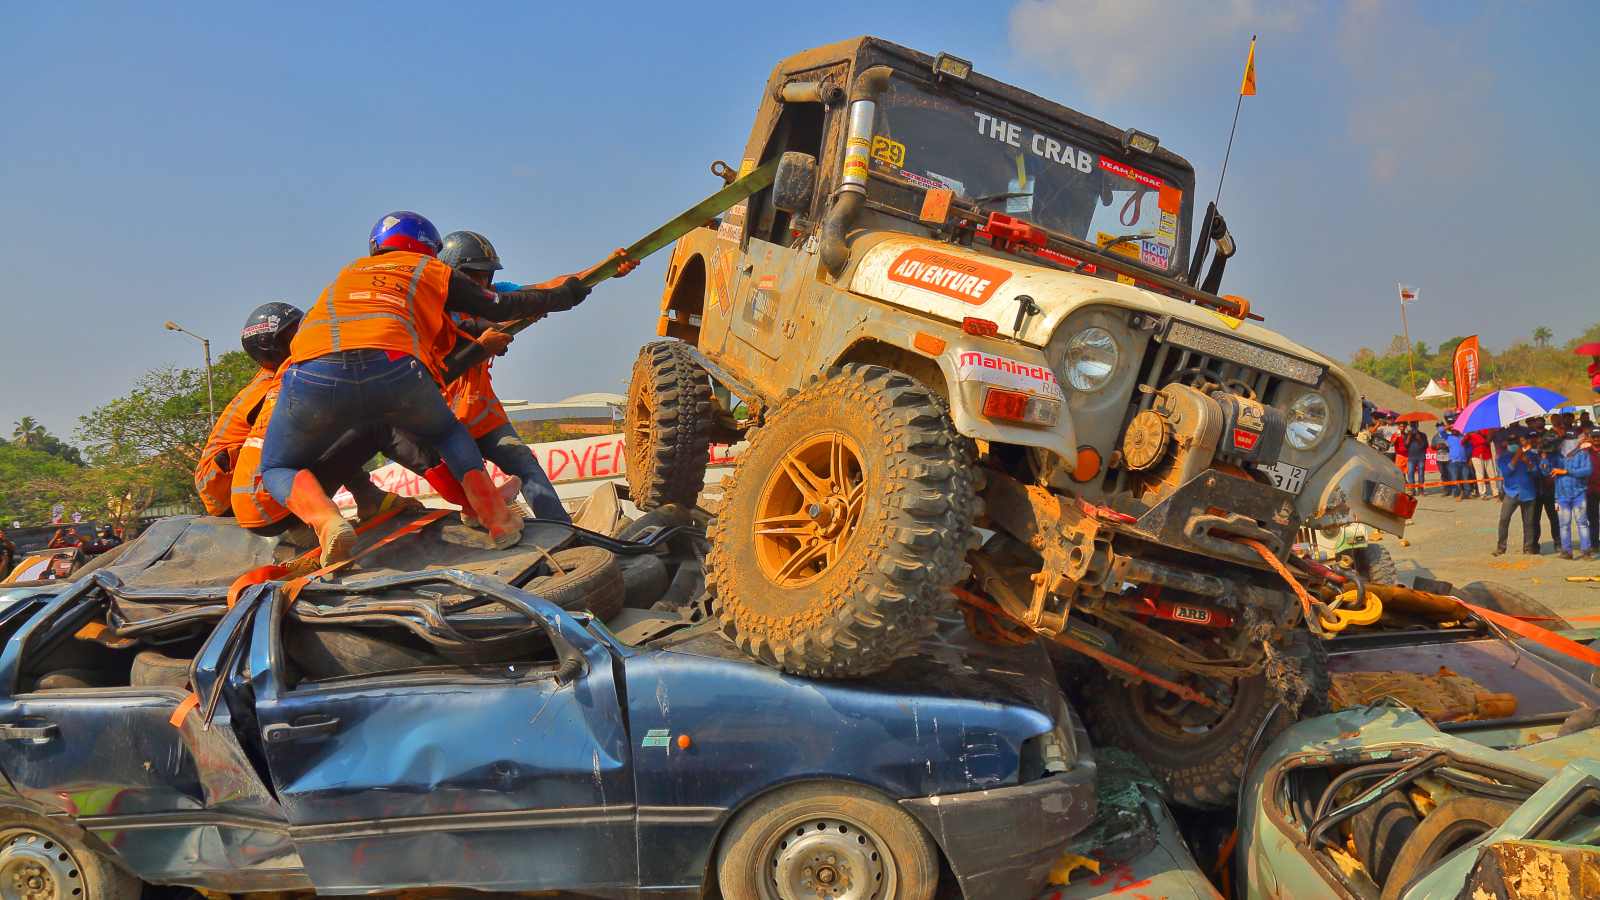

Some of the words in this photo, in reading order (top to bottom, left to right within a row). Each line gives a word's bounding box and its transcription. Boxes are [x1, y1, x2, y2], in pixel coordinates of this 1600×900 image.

[873, 138, 904, 164] 29
[974, 111, 1023, 148] THE
[1031, 133, 1093, 174] CRAB
[1099, 158, 1129, 176] TEAM
[1142, 240, 1169, 258] LIQUI
[1141, 252, 1169, 269] MOLY
[893, 258, 992, 299] ADVENTURE
[1290, 466, 1303, 479] 12
[1177, 607, 1207, 621] ARB
